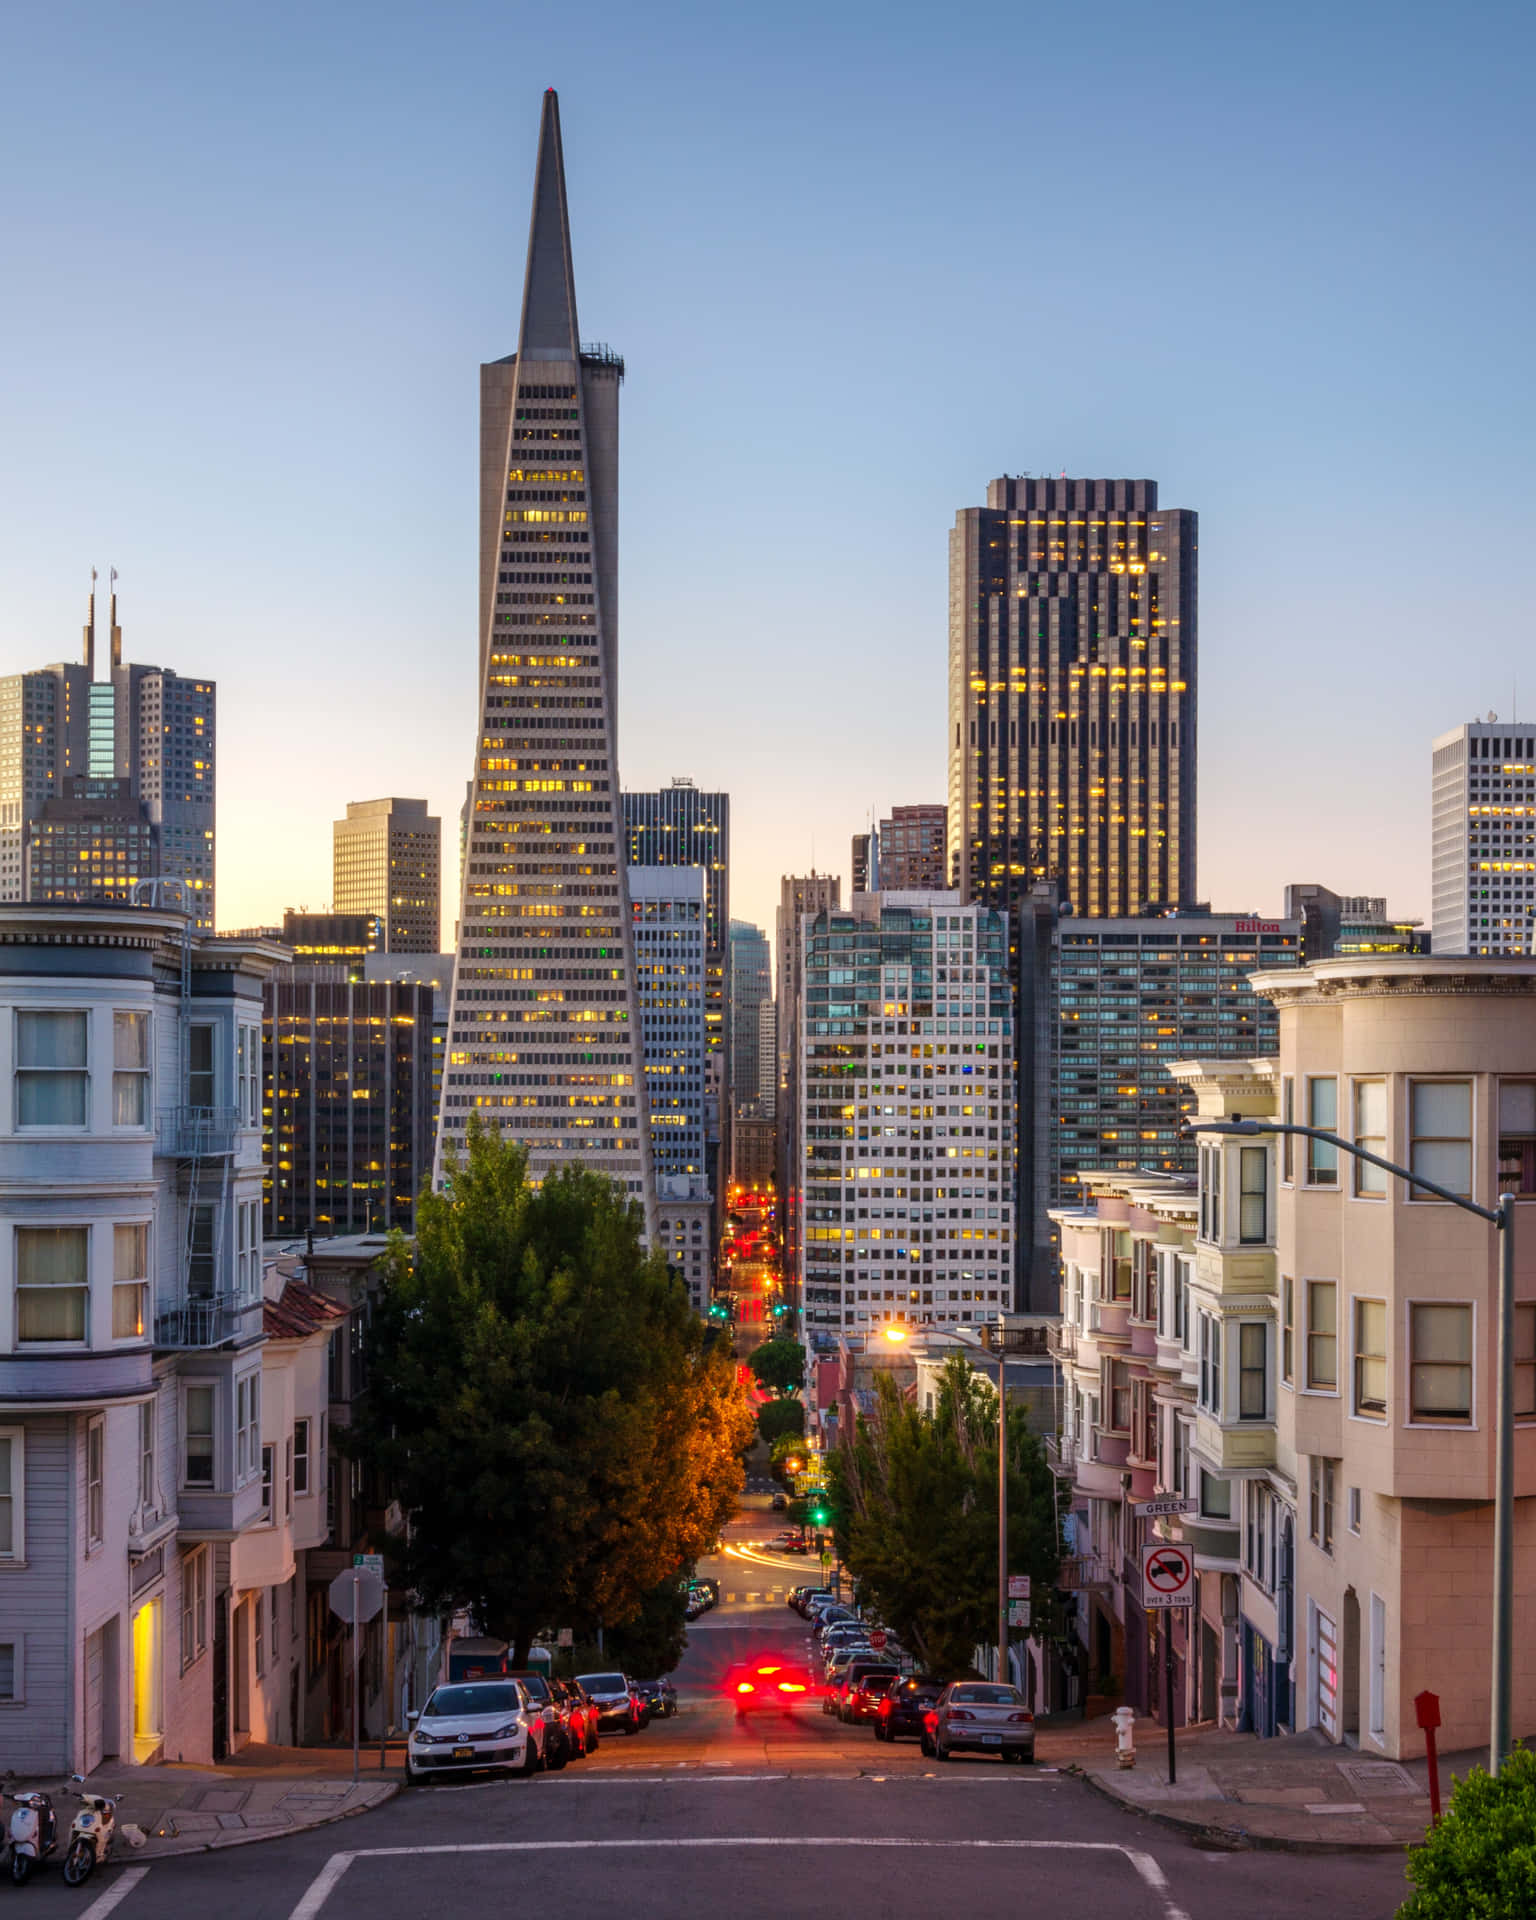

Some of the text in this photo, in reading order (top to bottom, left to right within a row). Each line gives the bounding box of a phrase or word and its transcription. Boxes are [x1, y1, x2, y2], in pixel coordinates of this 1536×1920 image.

[1235, 920, 1280, 933] Hilton
[1146, 1502, 1188, 1513] GREEN
[1166, 1594, 1172, 1604] 3
[870, 1635, 886, 1643] STOP
